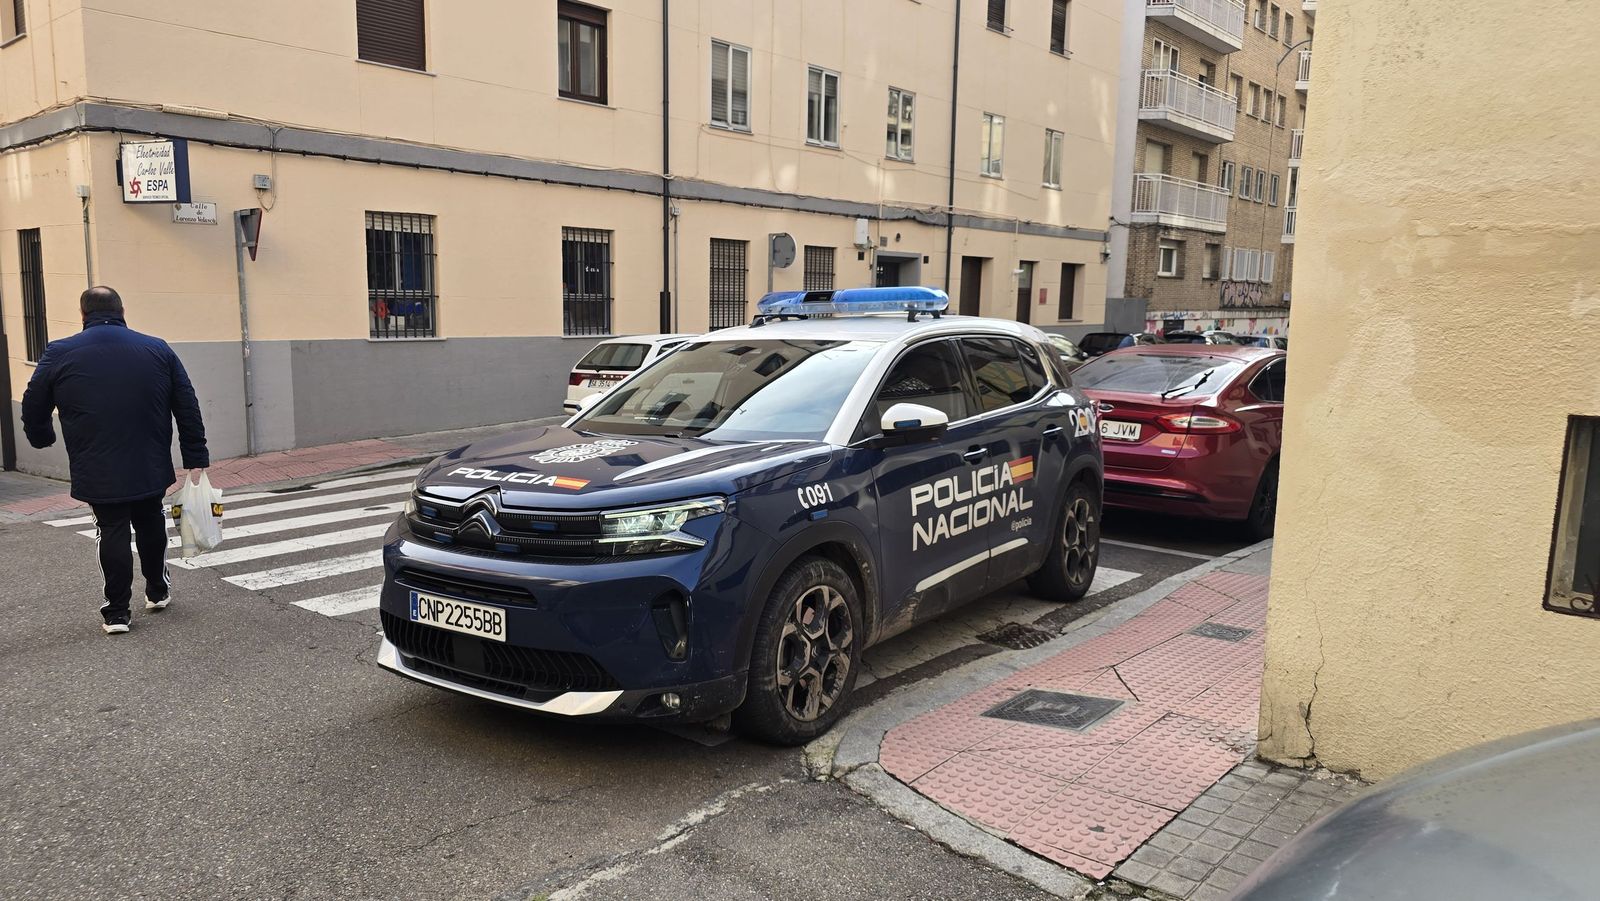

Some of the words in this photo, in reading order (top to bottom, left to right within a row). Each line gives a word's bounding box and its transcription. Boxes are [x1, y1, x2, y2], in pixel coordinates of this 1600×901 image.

[136, 145, 171, 159] Electricidad
[137, 162, 157, 176] Carlos
[159, 161, 175, 176] Valle
[146, 179, 169, 191] ESPA
[1113, 423, 1137, 437] JVM
[447, 467, 558, 487] POLICIA
[805, 482, 834, 507] 091
[912, 487, 1033, 552] NACIONAL
[418, 597, 502, 636] CNP2255BB
